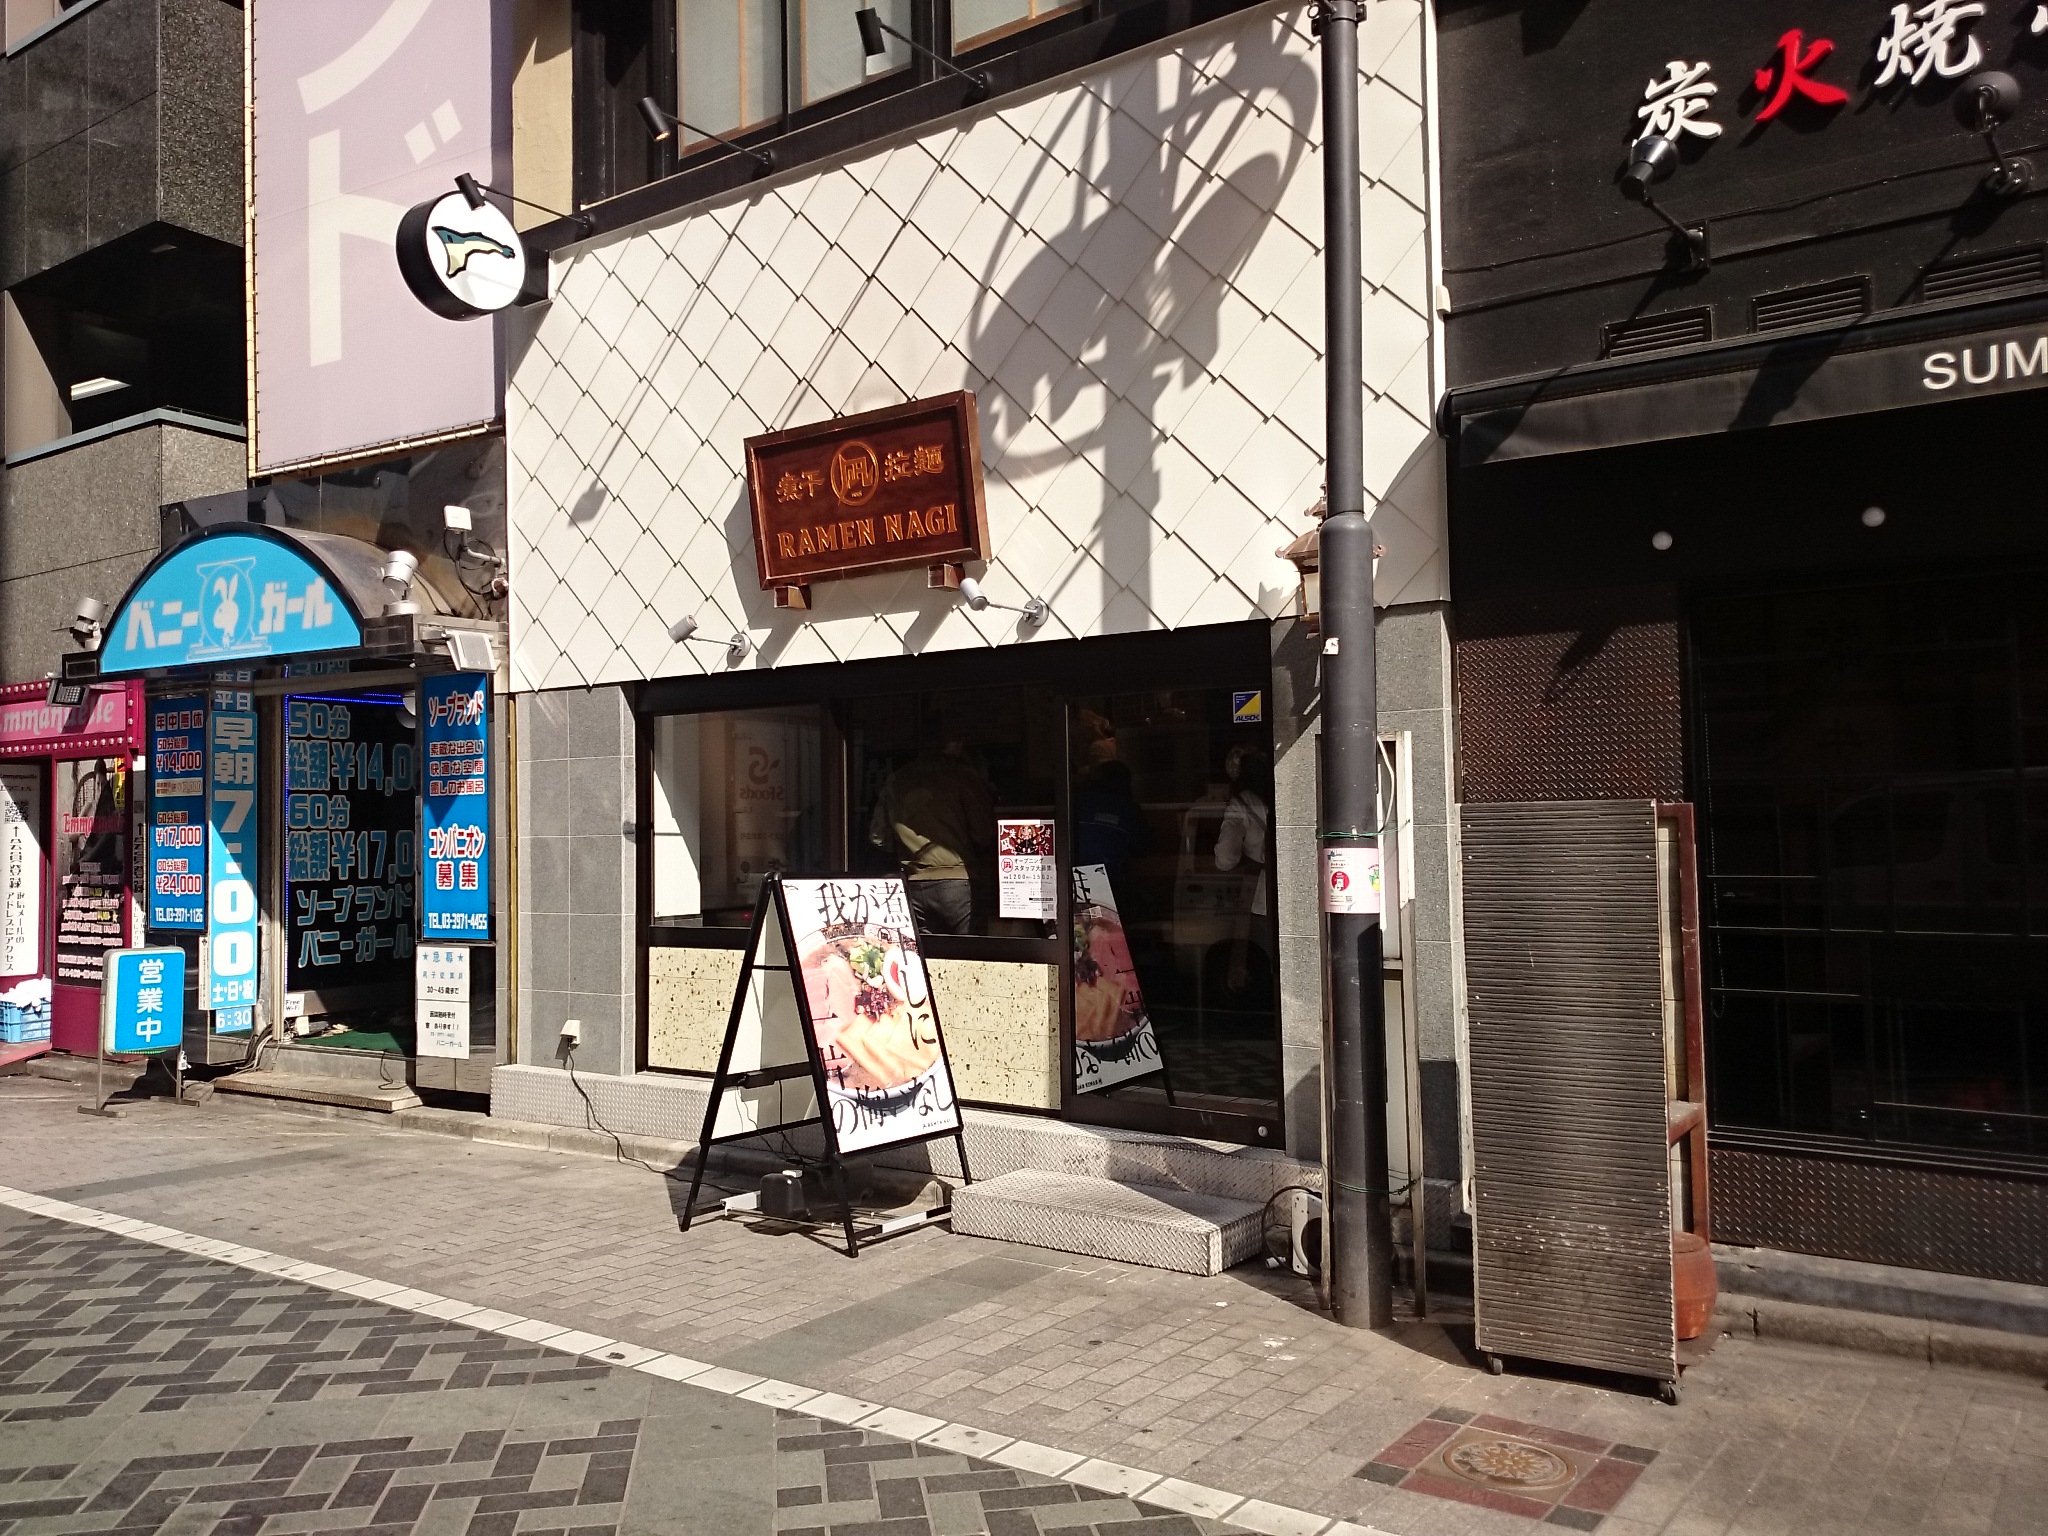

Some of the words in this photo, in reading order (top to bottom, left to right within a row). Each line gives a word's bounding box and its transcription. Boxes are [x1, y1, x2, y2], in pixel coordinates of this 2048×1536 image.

[1632, 2, 2047, 147] 炭火焼
[777, 518, 876, 559] RAMEN
[884, 503, 958, 543] NAGI
[125, 600, 199, 651] バニー
[259, 577, 333, 635] ガール
[215, 690, 251, 711] 平日
[429, 690, 484, 728] ソープランド
[155, 710, 203, 731] 年中無休
[288, 702, 350, 740] 50分
[157, 736, 188, 751] 50分総額
[430, 739, 484, 757] 素敵な出会い
[156, 750, 202, 774] ¥14,000
[430, 758, 484, 776] 快適な空間
[430, 779, 484, 796] 癒しのお風呂
[288, 794, 350, 829] 60分
[155, 826, 202, 849] ¥17,000
[156, 874, 202, 897] ¥24,000
[436, 861, 478, 890] 募集
[296, 883, 414, 926] ソープランド
[298, 924, 413, 968] バニーガール
[136, 958, 164, 1043] 営業中
[216, 1009, 251, 1029] 6:30
